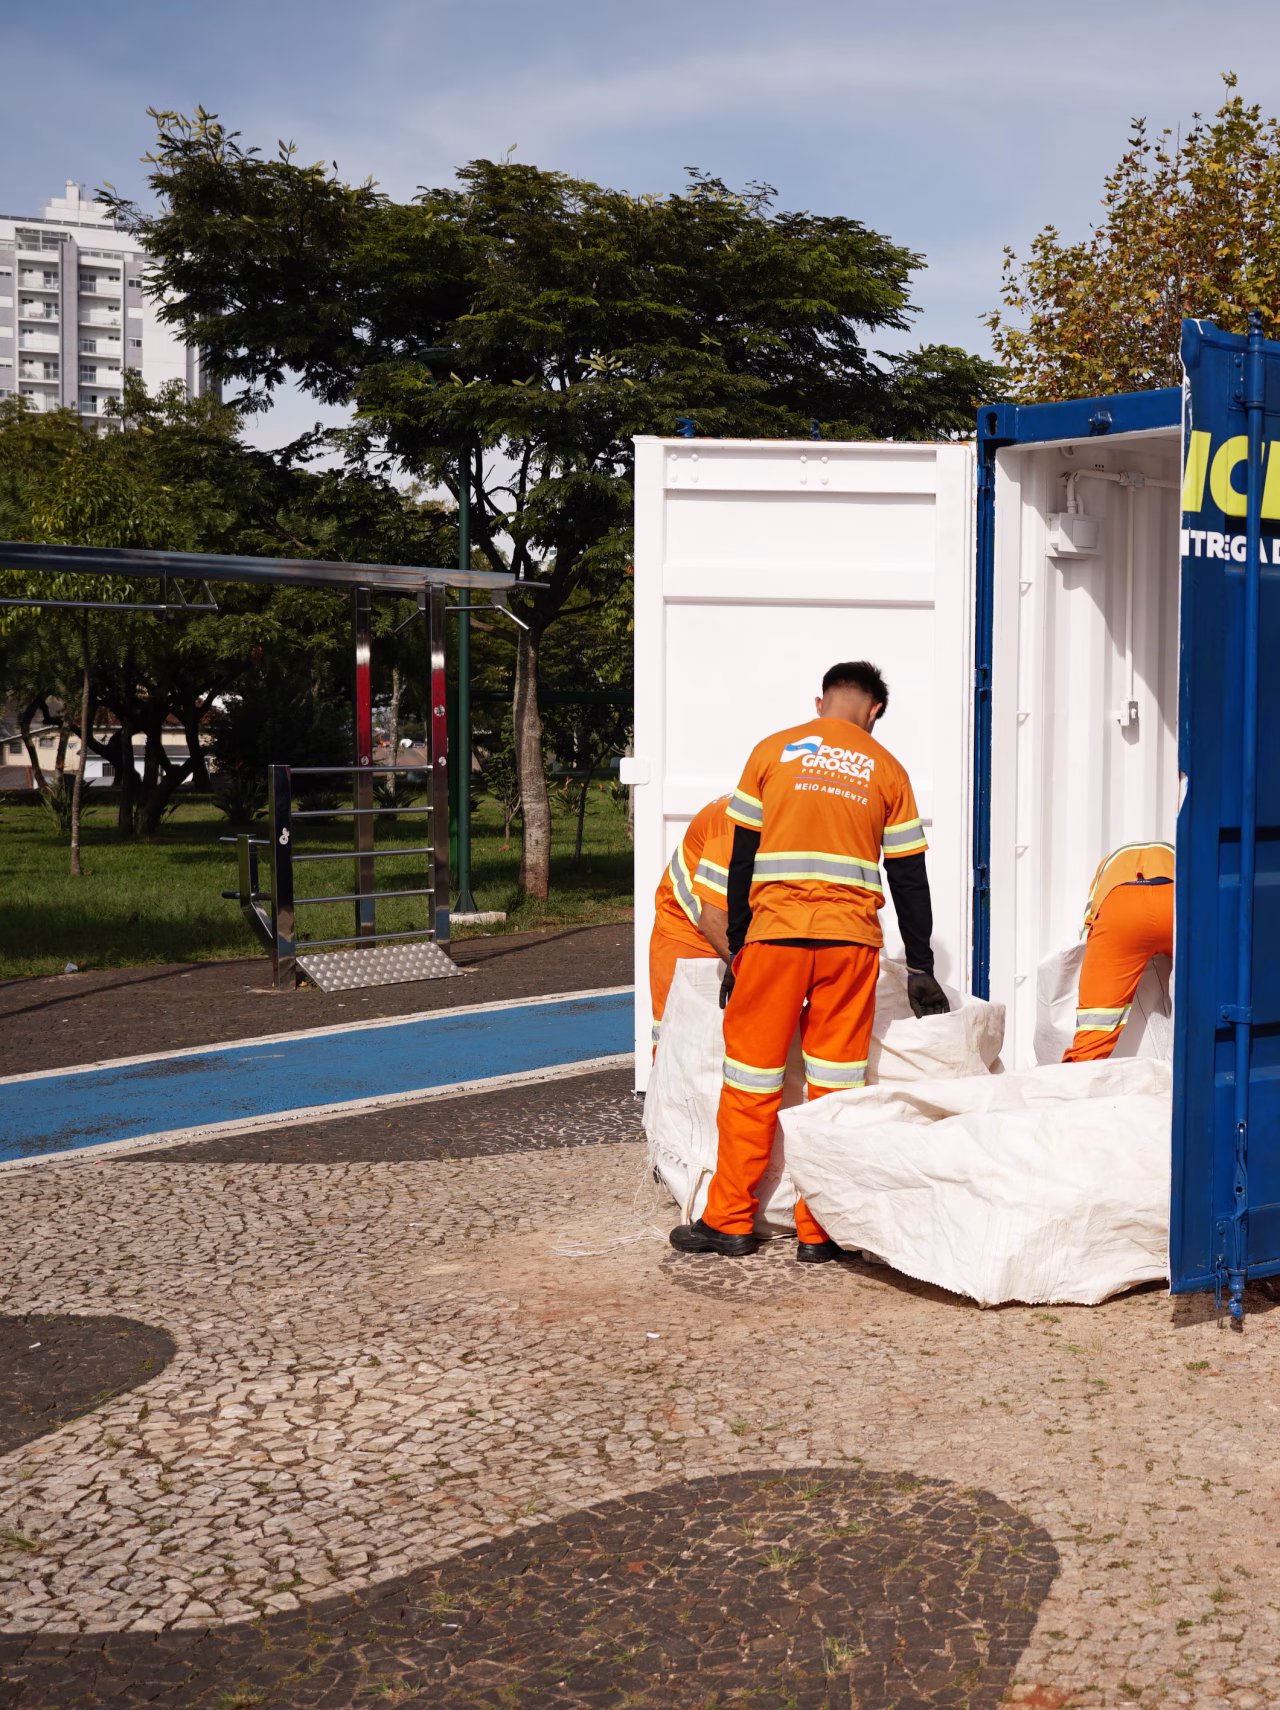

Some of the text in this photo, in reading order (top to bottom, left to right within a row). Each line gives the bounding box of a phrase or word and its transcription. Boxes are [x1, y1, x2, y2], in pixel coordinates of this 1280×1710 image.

[801, 754, 871, 782] GROSSA
[818, 744, 875, 772] PONTA
[801, 768, 868, 788] PREFEITURA
[794, 783, 868, 805] MEIO AMBIENTE
